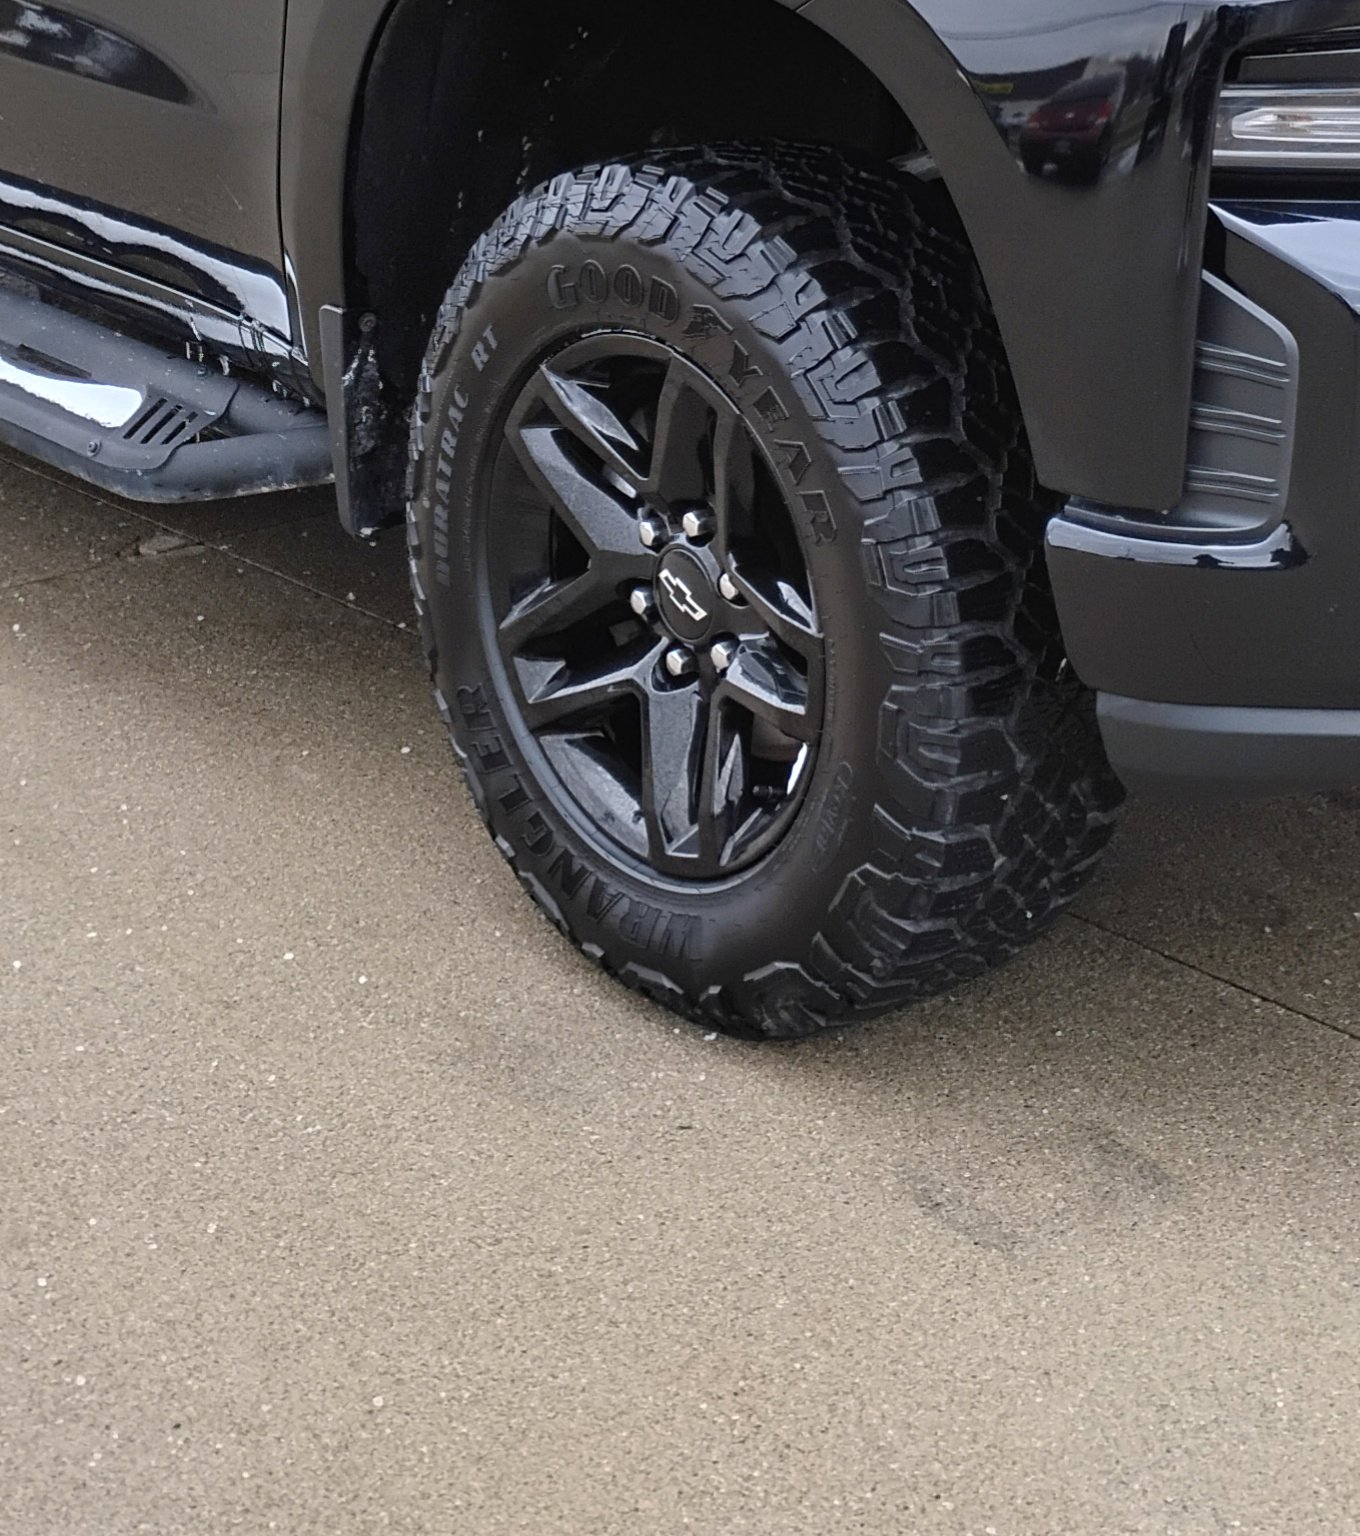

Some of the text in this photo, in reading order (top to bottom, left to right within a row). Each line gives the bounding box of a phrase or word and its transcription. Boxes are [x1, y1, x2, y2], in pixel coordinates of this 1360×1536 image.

[433, 383, 470, 587] DURATRAC
[546, 259, 838, 545] GOODYEAR
[457, 683, 703, 961] WRANGLER
